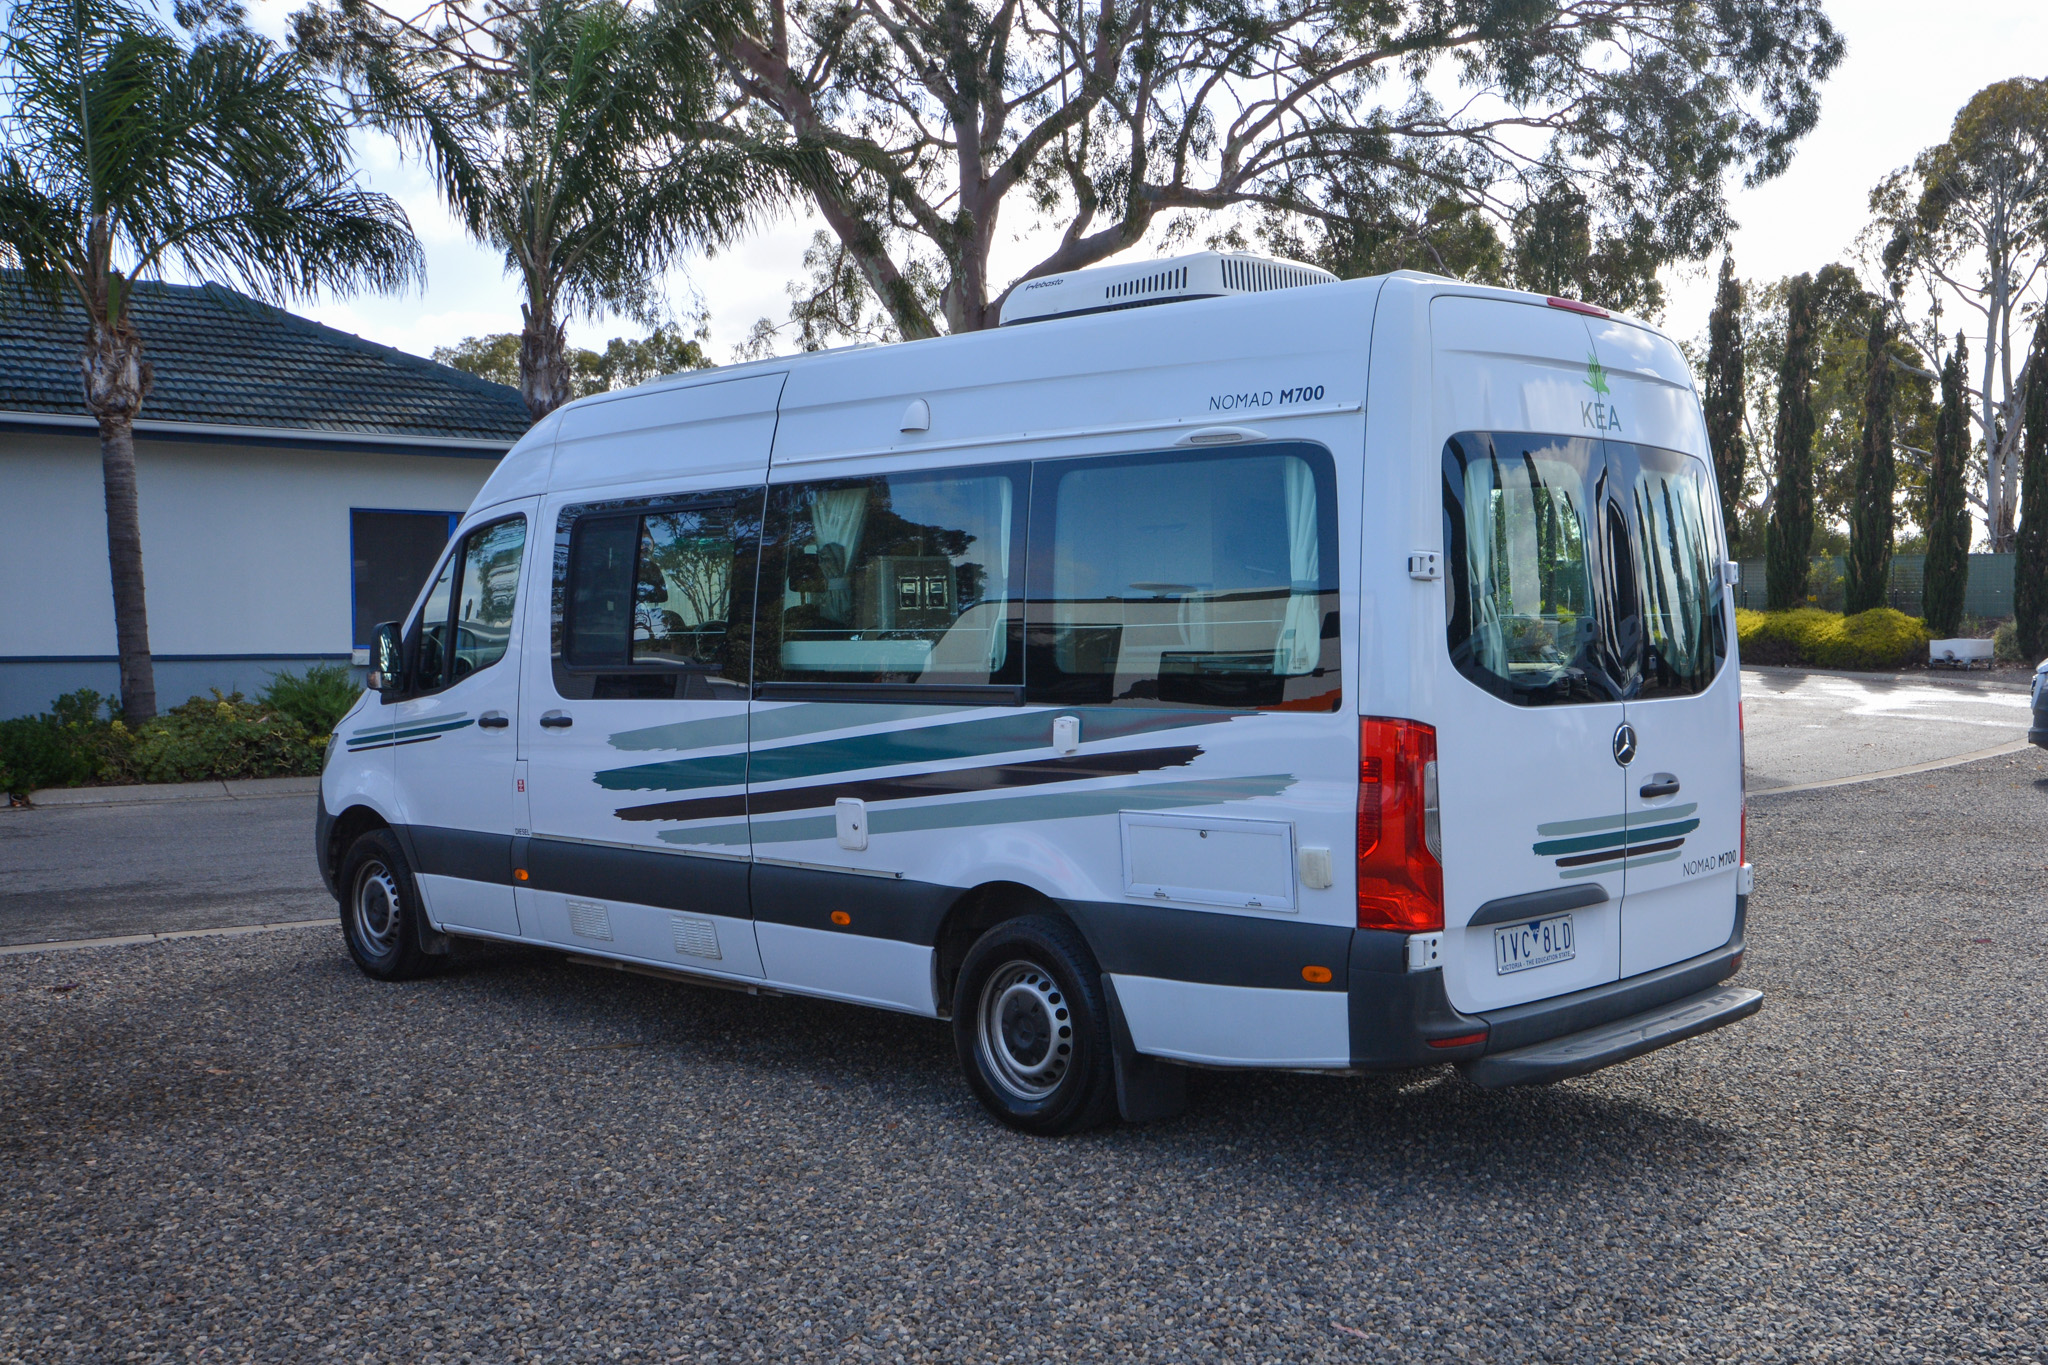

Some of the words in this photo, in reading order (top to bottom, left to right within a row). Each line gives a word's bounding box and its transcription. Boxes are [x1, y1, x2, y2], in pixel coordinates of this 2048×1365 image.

[1209, 391, 1273, 411] NOMAD
[1279, 385, 1325, 405] M700
[1581, 400, 1622, 432] KEA
[1683, 856, 1716, 877] NOMAD
[1718, 849, 1737, 868] M700
[1501, 931, 1530, 962] 1VC
[1543, 923, 1571, 953] 8LD
[1502, 962, 1522, 971] VICTORIA
[1535, 954, 1558, 964] EDUCATION
